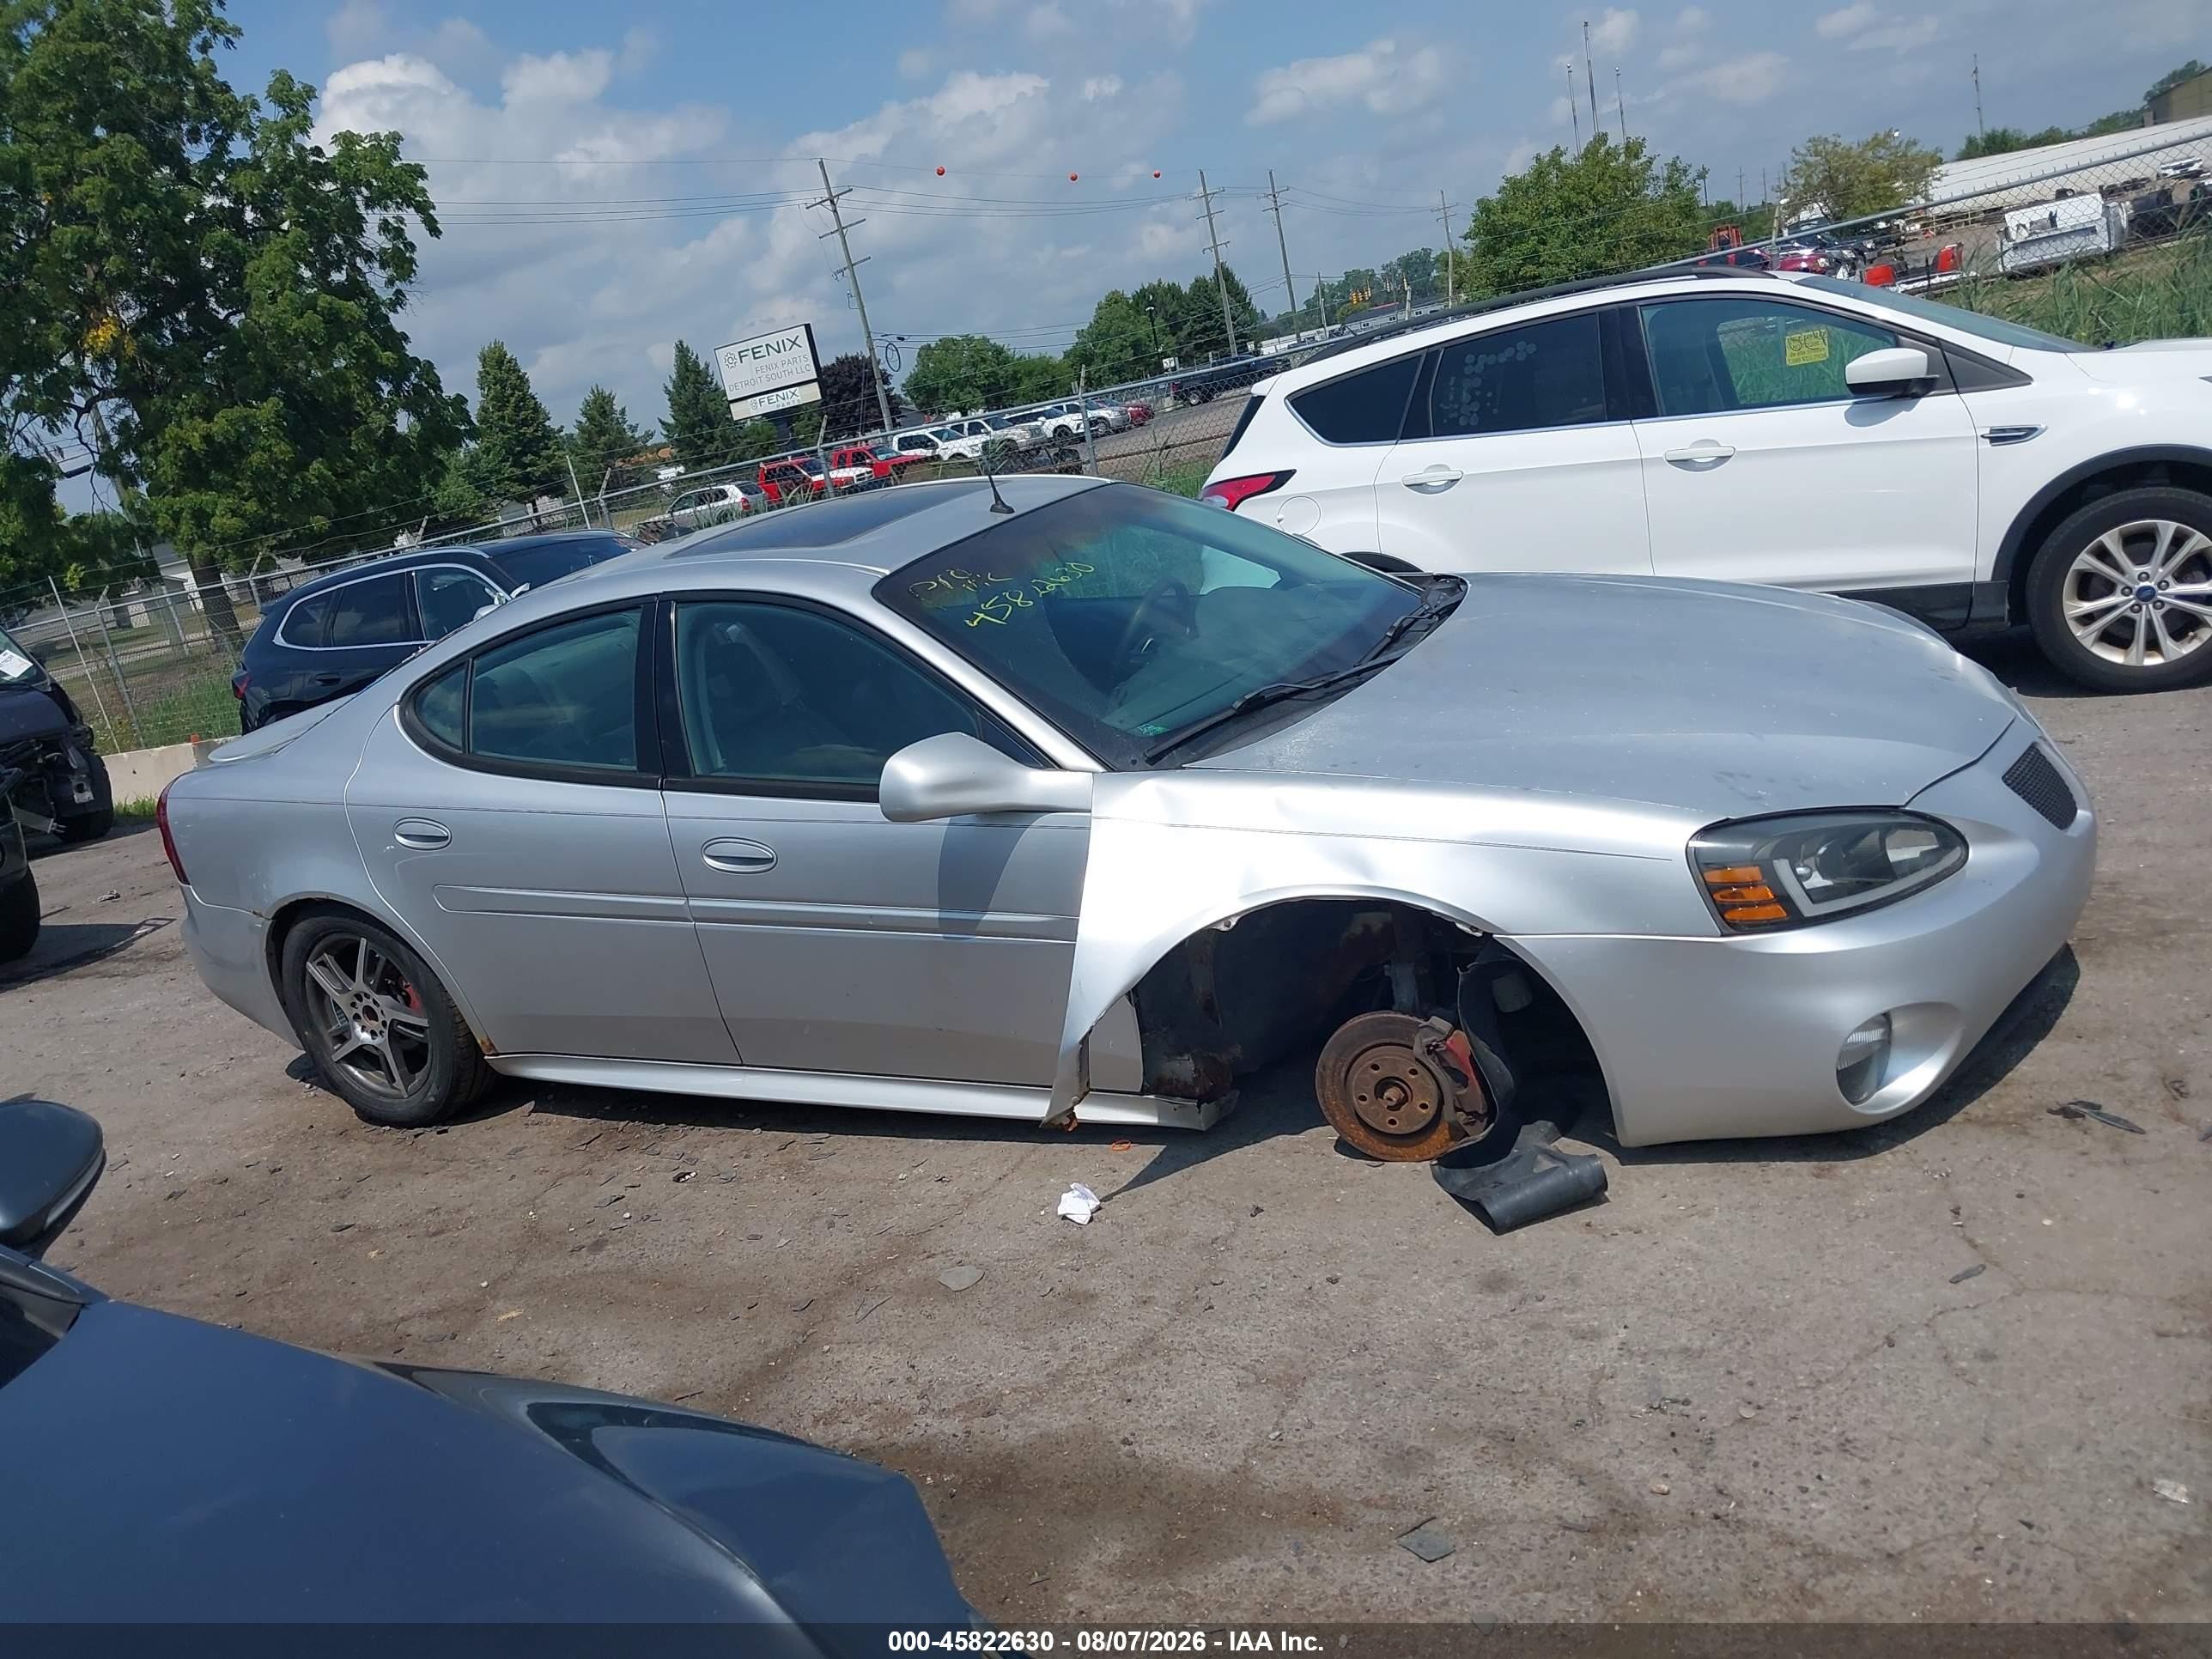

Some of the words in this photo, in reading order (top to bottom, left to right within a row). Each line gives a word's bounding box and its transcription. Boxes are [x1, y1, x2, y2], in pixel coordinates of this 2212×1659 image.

[738, 335, 803, 364] FENIX
[755, 362, 779, 374] FENIX
[781, 354, 808, 367] PARTS
[729, 376, 763, 392] DETROIT
[765, 369, 793, 382] SOUTH
[796, 364, 811, 374] LLC
[758, 388, 799, 407] FENIX
